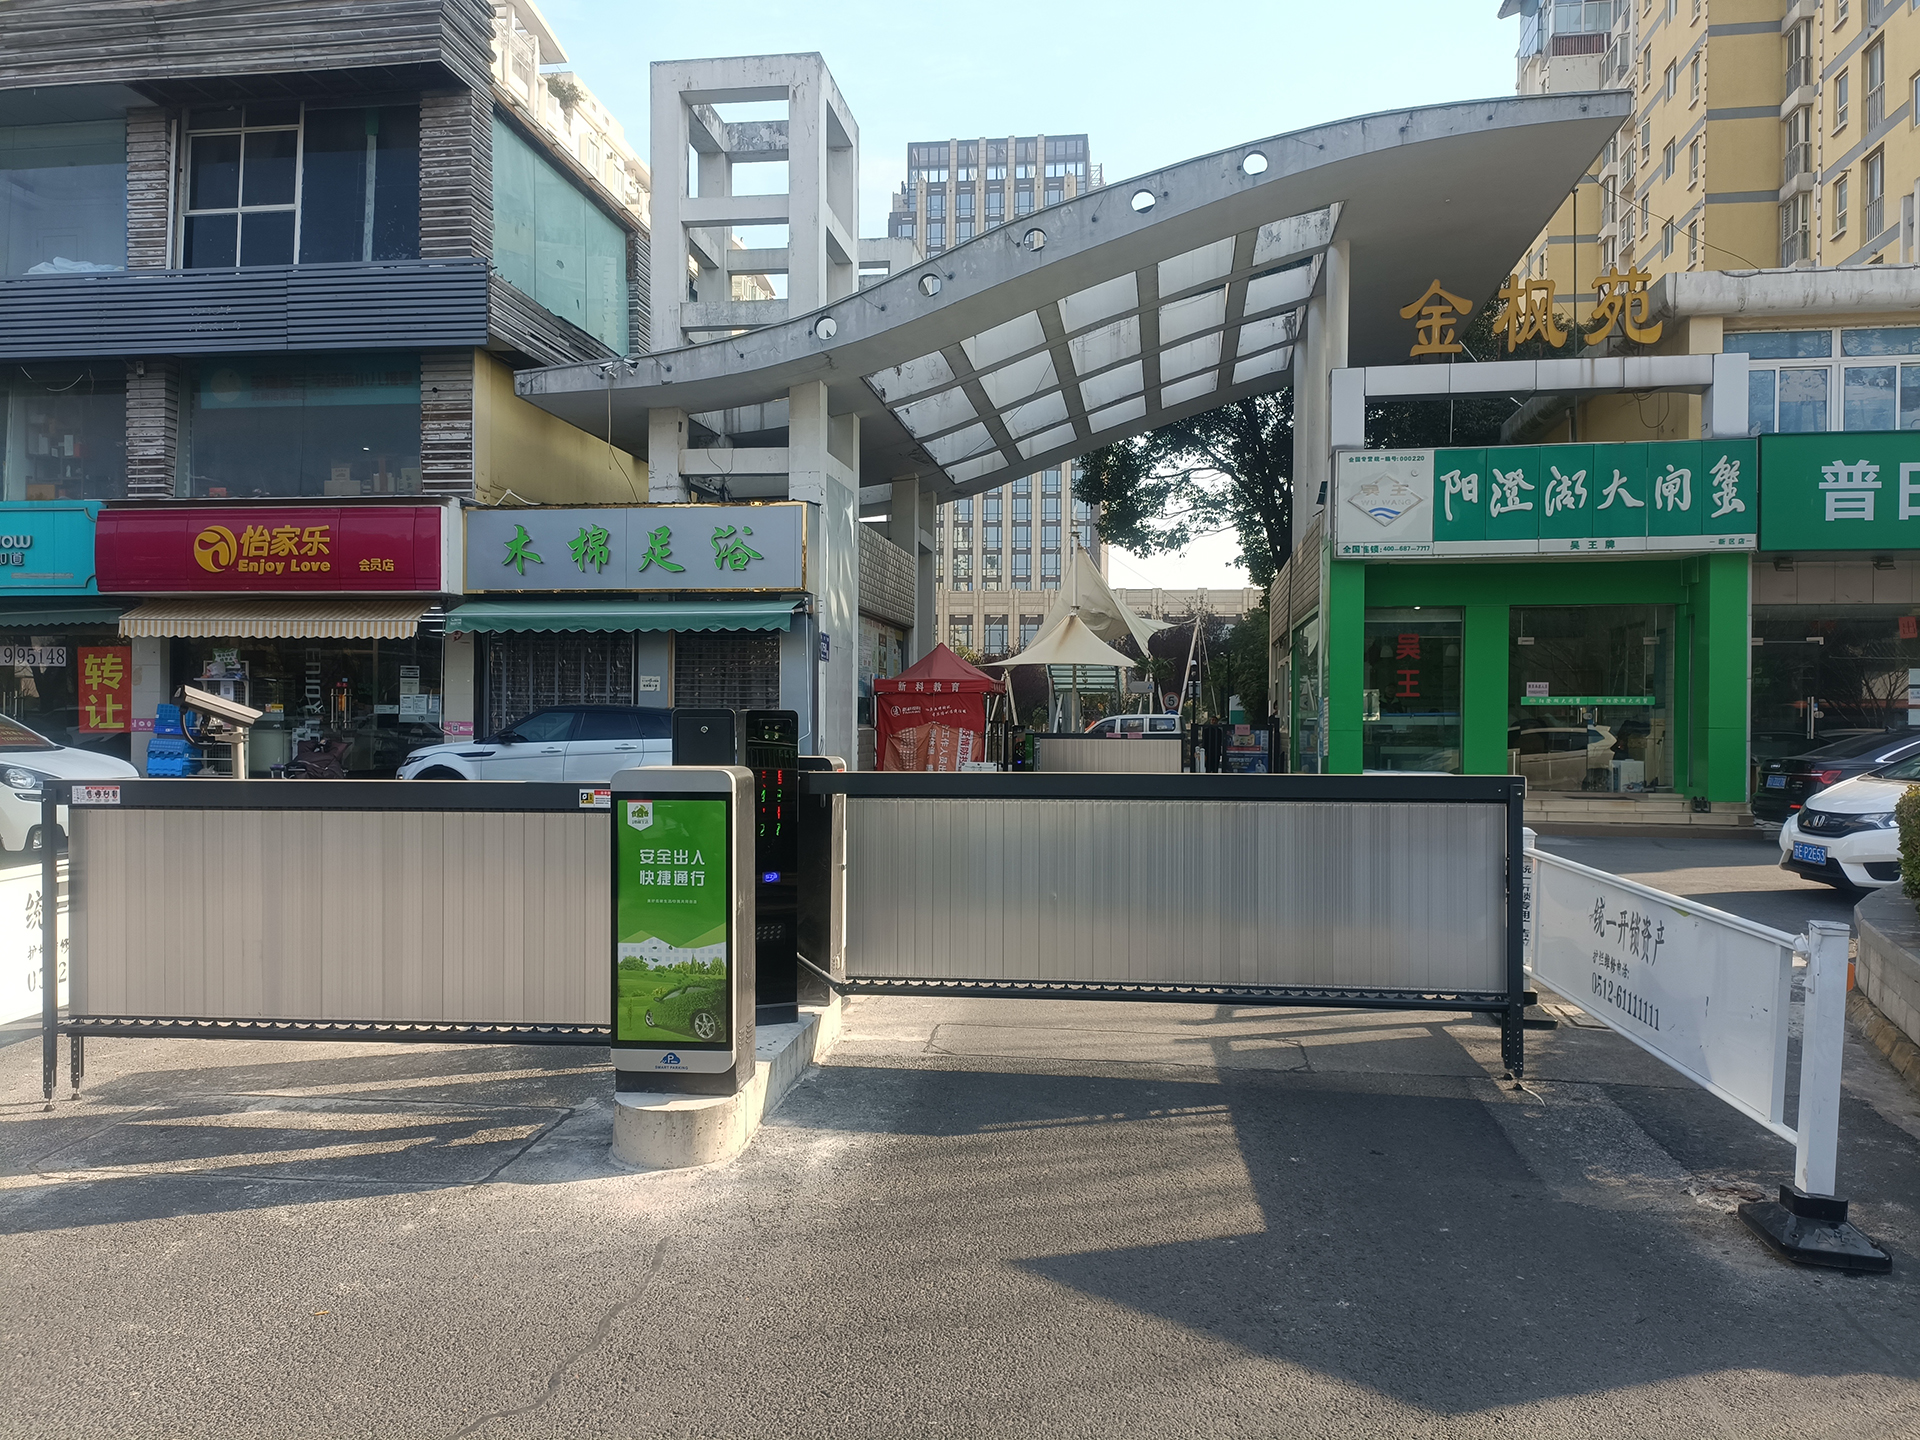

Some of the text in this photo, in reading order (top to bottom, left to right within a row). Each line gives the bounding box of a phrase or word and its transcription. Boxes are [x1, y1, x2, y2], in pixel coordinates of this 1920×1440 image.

[1400, 266, 1663, 357] 金枫苑
[1439, 453, 1746, 521] 阳澄湖大闸蟹
[0, 535, 32, 549] ow
[240, 525, 330, 557] 怡家乐
[502, 524, 763, 576] 木棉足浴
[238, 559, 331, 575] Enjoy Love
[358, 558, 395, 572] 会员店
[1396, 633, 1420, 697] 吴王
[84, 653, 124, 728] 转让
[898, 681, 960, 692] 新科教育
[1168, 696, 1175, 707] 5
[640, 870, 705, 886] 快捷通行
[1591, 896, 1665, 967] 统一开锁资产
[1592, 972, 1660, 1031] 0512-61111111
